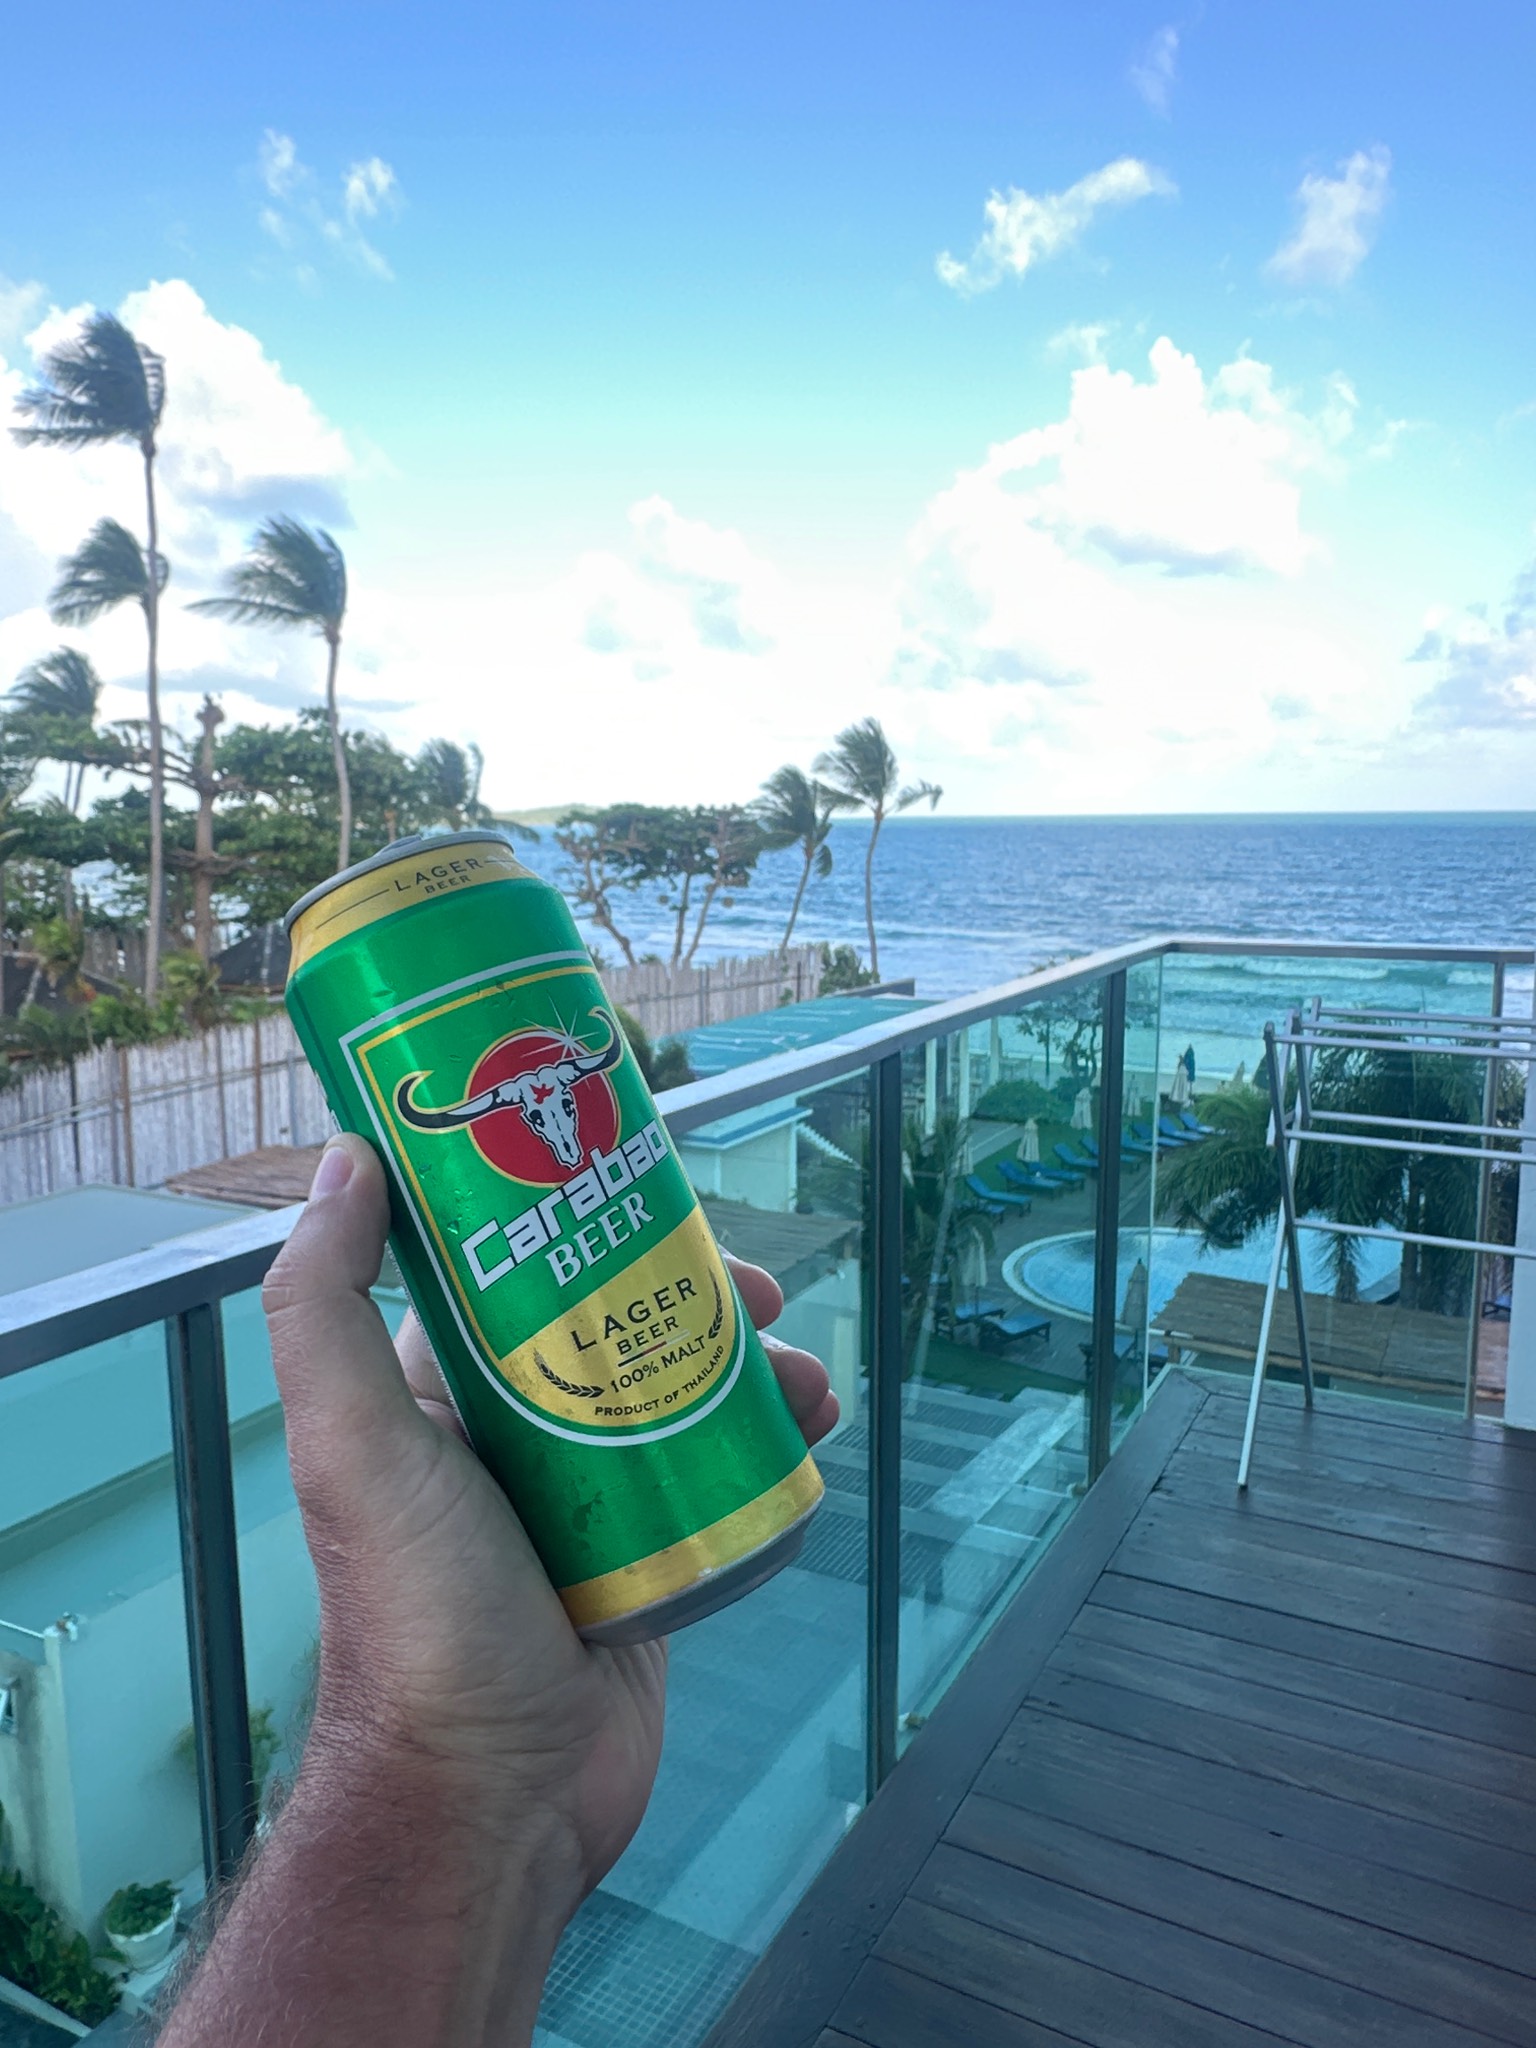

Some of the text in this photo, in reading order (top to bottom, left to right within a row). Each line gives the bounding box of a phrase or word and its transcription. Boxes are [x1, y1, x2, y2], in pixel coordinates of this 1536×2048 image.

[394, 858, 484, 892] LAGER
[423, 874, 472, 894] BEER
[460, 1118, 669, 1293] Carabao
[545, 1192, 655, 1287] BEER
[570, 1277, 697, 1353] LAGER
[616, 1315, 679, 1356] BEER
[594, 1345, 724, 1417] PRODUCT OF THAILAND
[610, 1335, 705, 1393] 100% MALT
